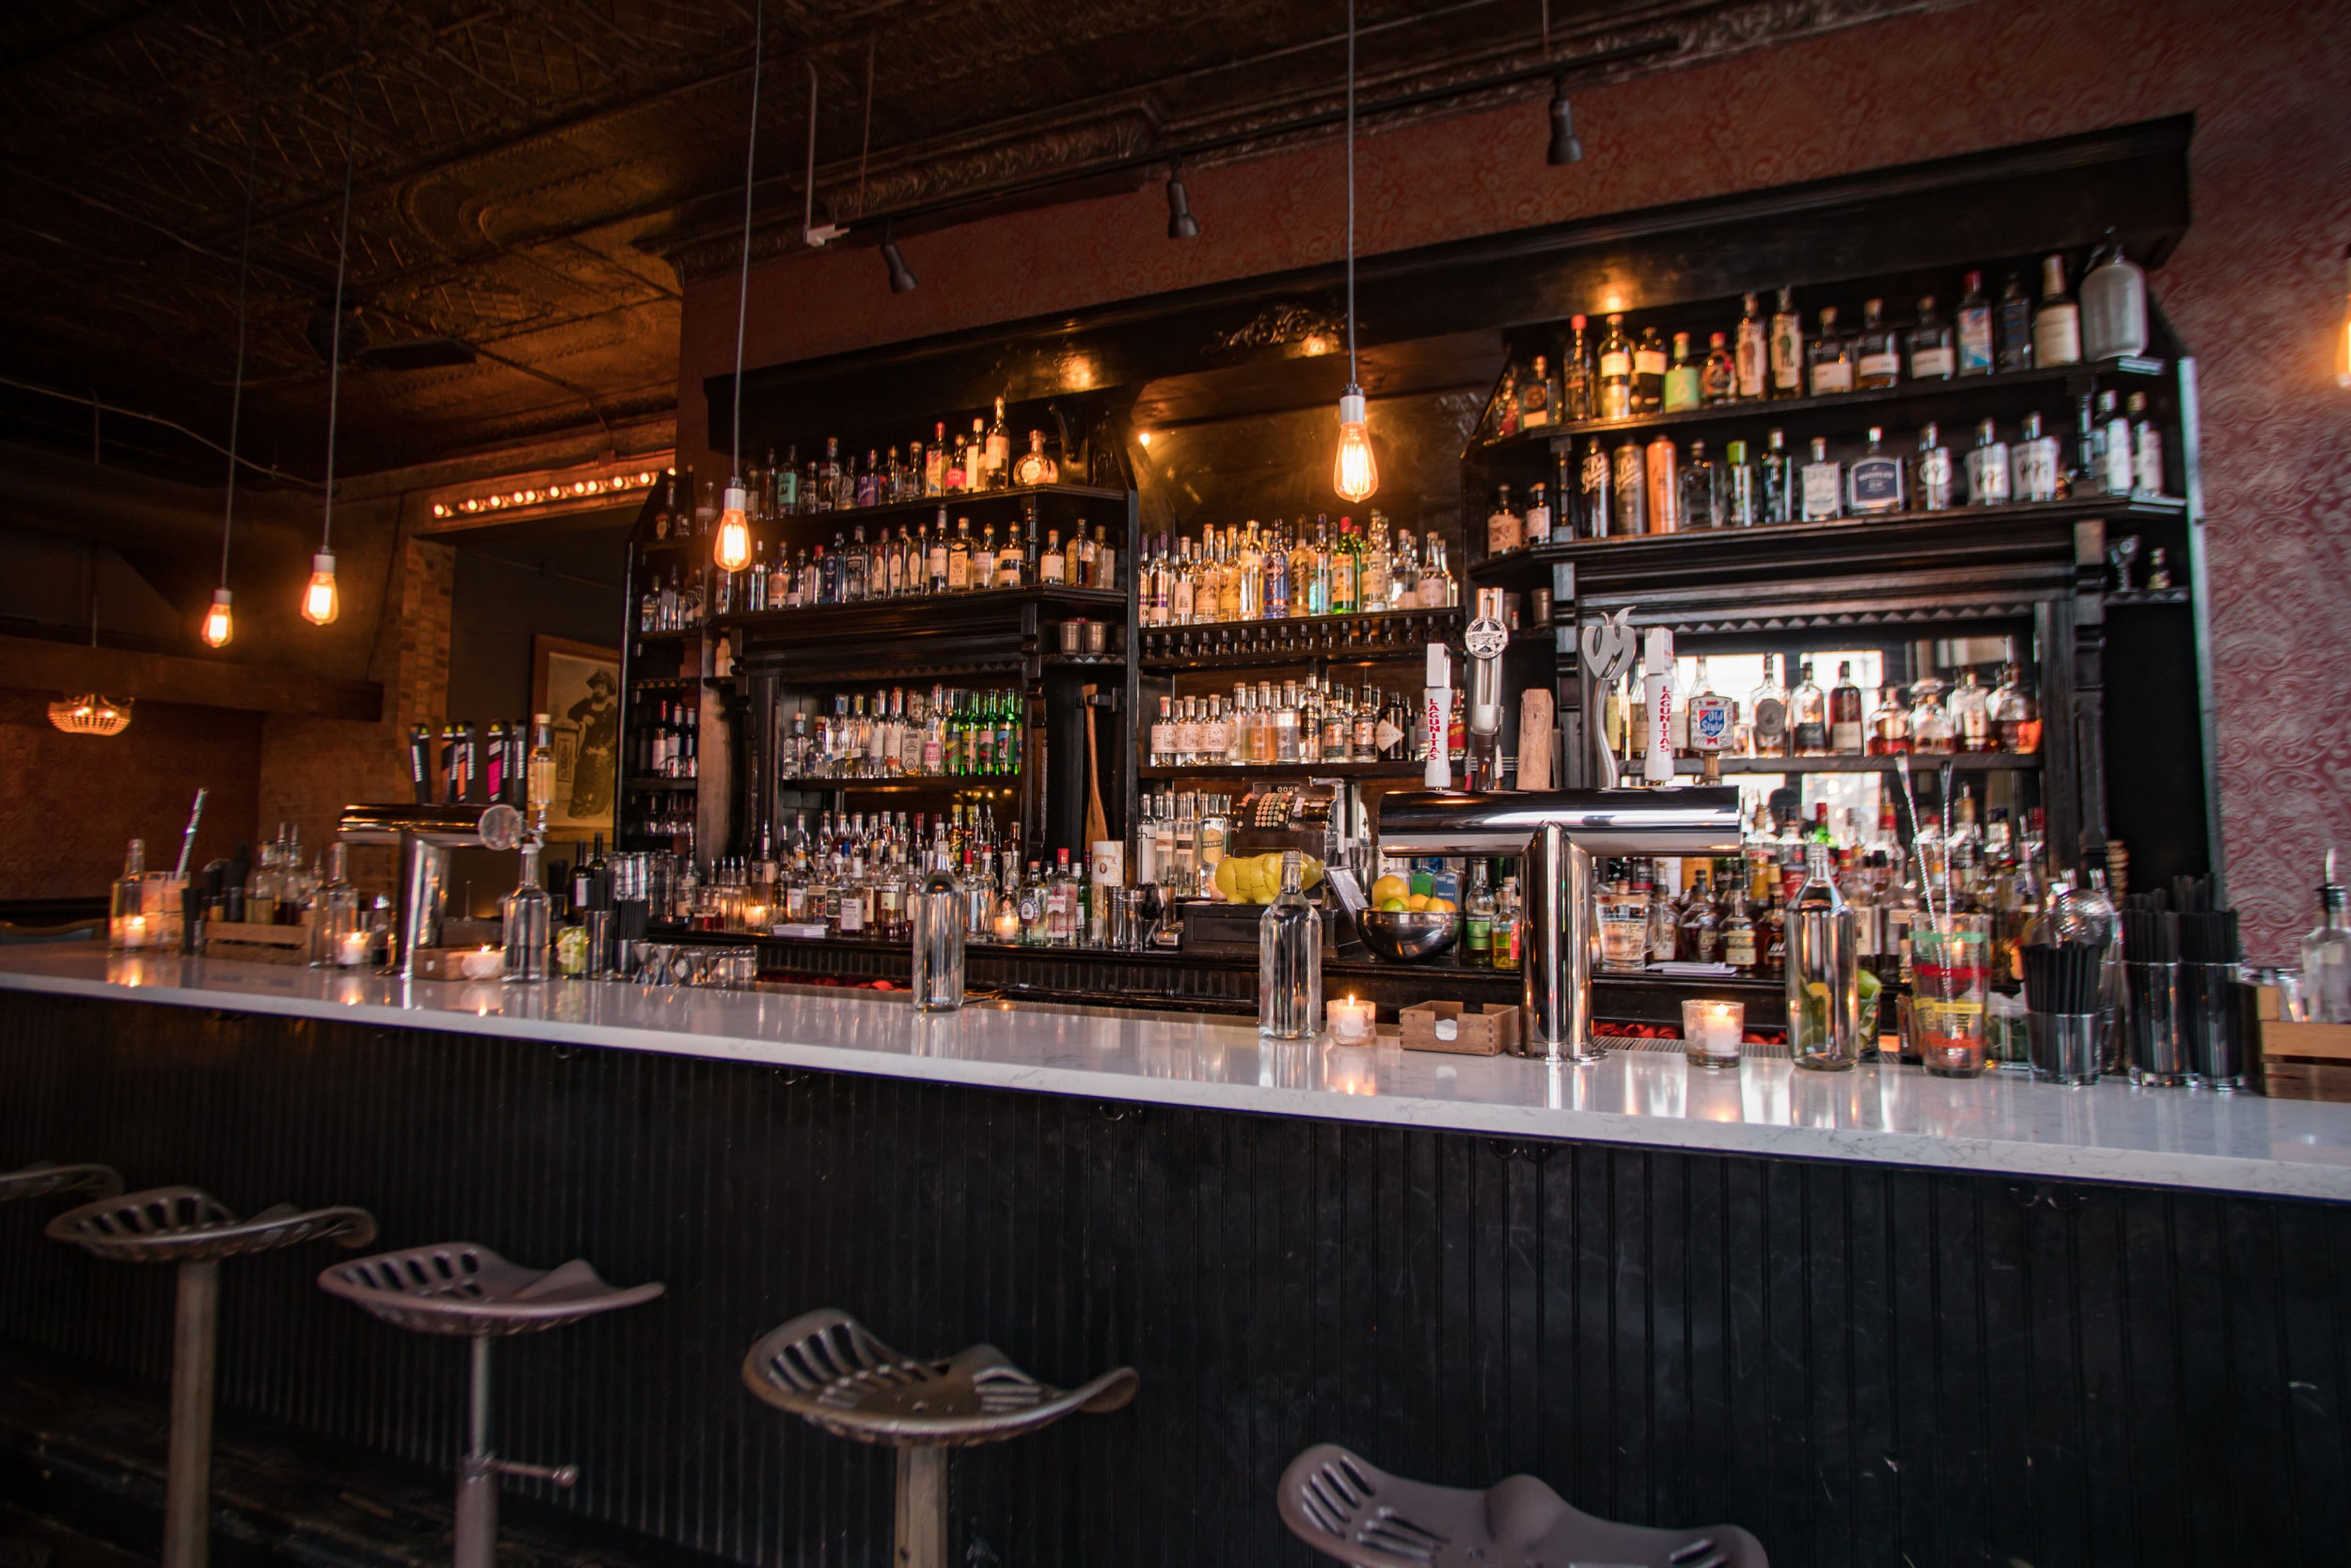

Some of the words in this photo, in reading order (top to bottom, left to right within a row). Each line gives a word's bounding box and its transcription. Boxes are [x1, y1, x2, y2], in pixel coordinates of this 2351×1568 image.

[1429, 698, 1440, 761] LAGUNITAS
[1659, 685, 1671, 752] LAGUNITAS
[1701, 720, 1723, 735] Style
[1708, 711, 1723, 721] Old
